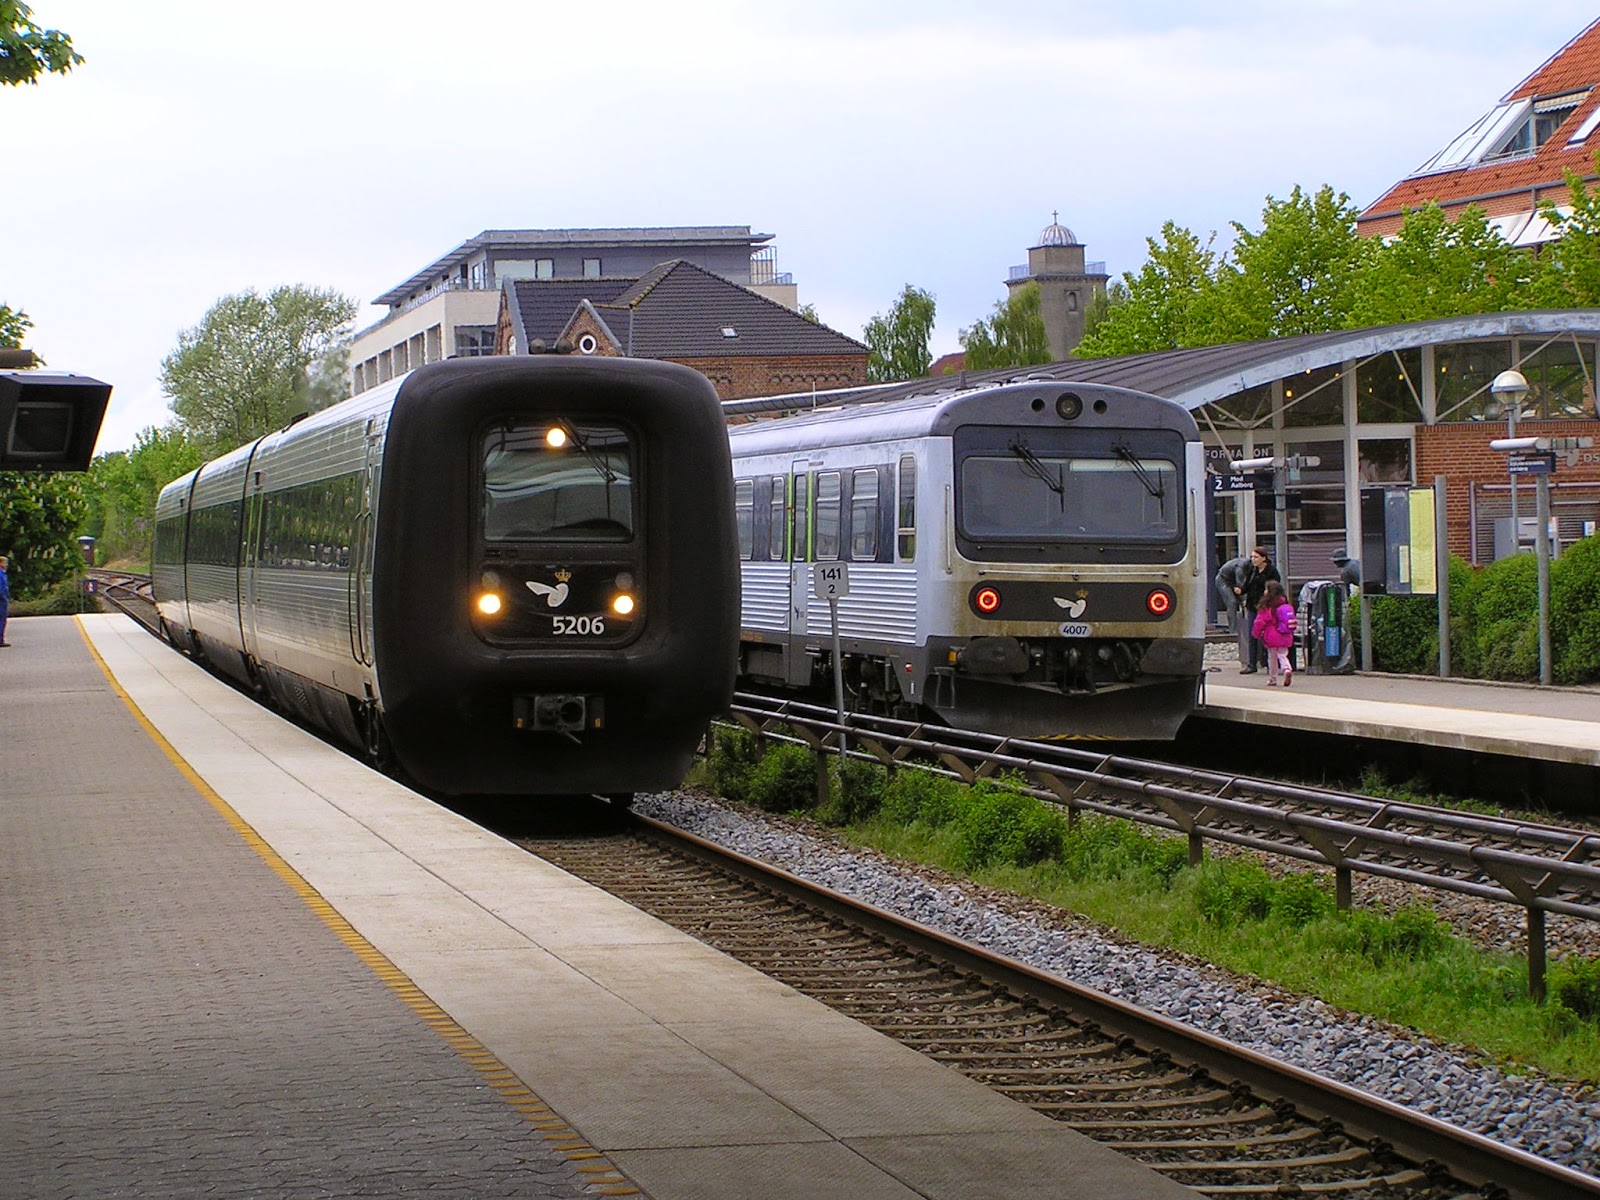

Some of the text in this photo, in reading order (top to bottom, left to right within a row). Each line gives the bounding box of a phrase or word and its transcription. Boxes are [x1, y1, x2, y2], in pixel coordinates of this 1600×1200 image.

[1215, 480, 1223, 490] 2
[821, 568, 841, 580] 141
[828, 584, 835, 593] 2
[553, 616, 604, 635] 5206
[1063, 625, 1087, 635] 4007
